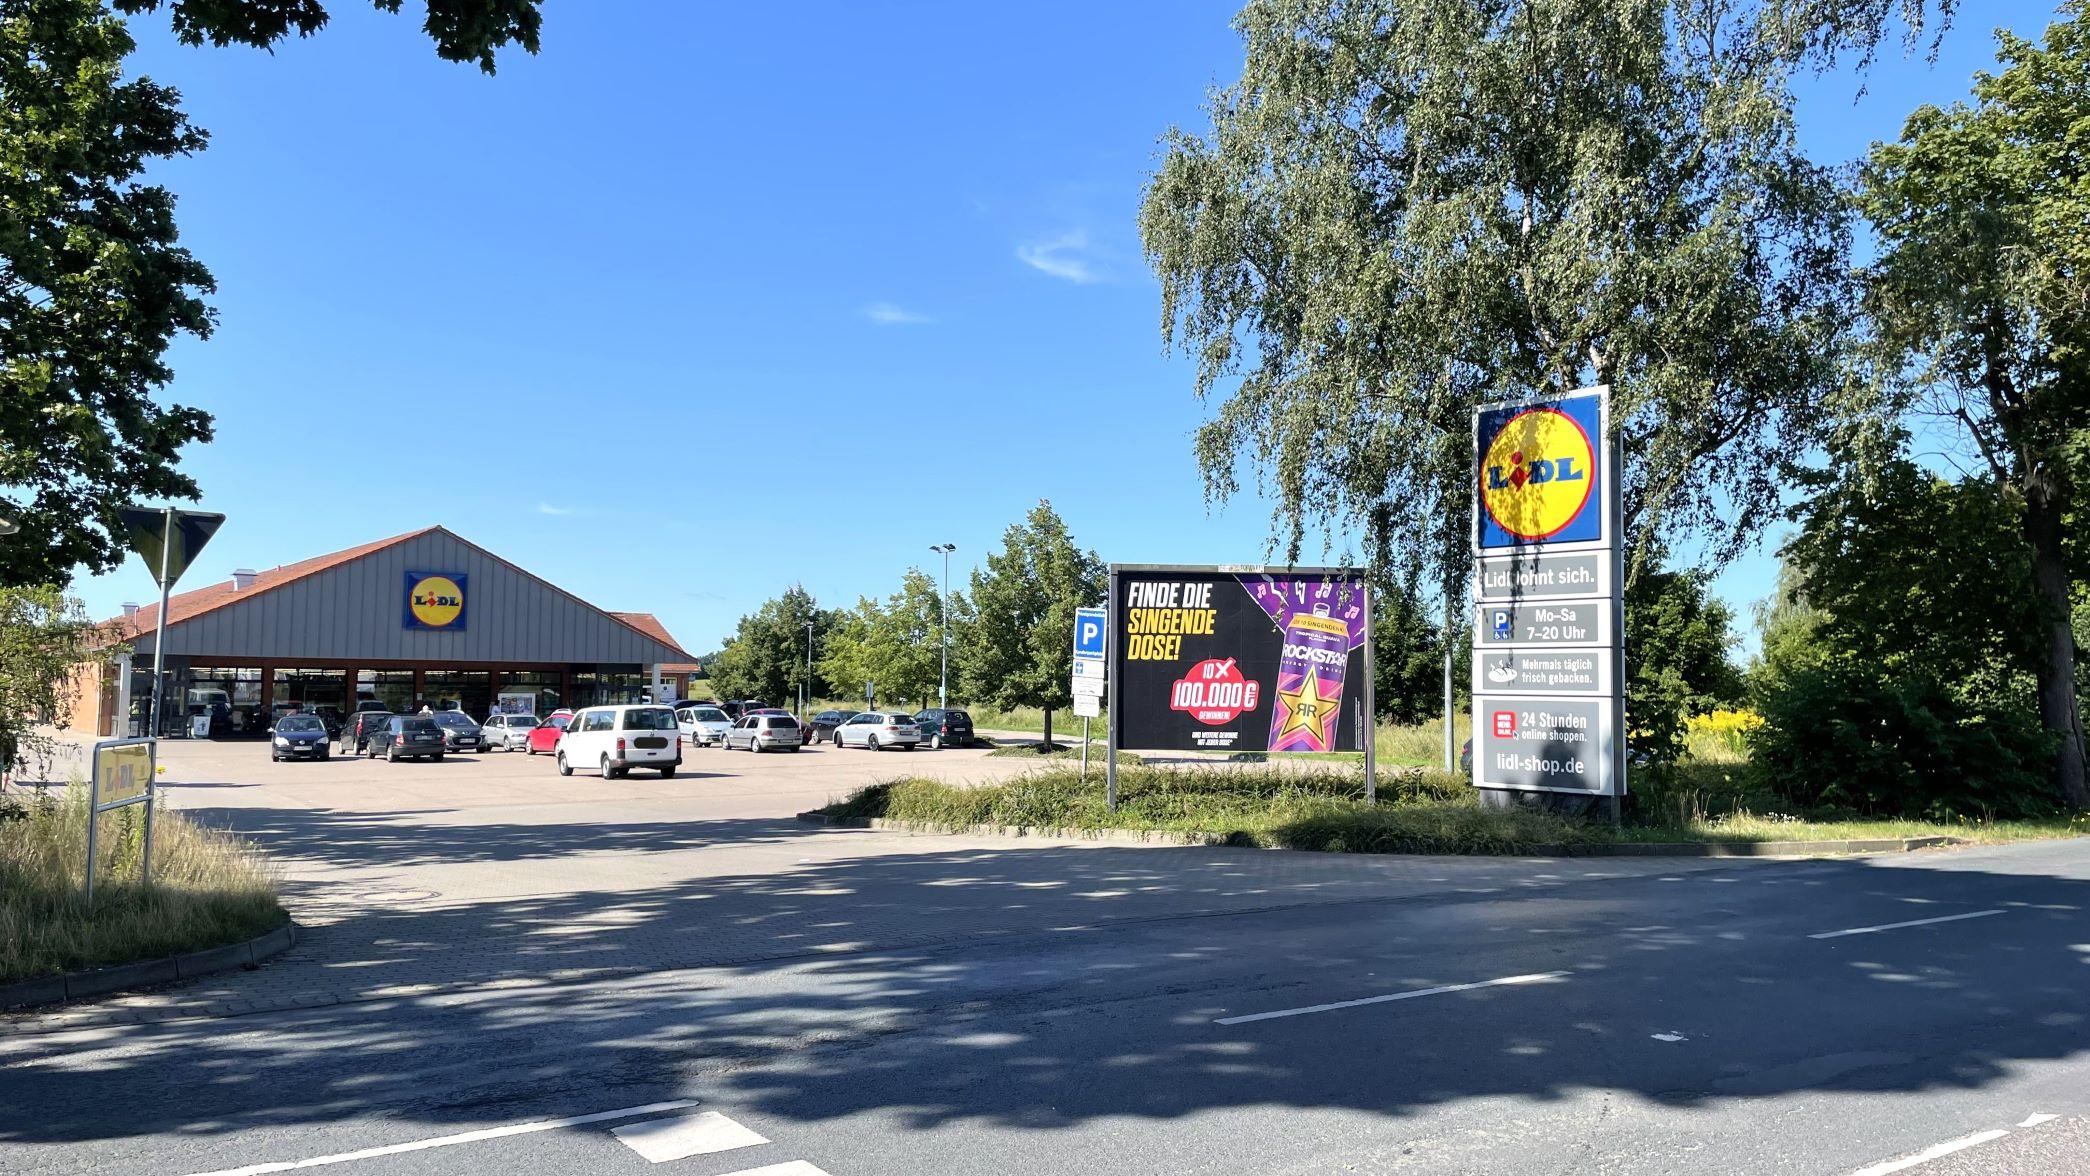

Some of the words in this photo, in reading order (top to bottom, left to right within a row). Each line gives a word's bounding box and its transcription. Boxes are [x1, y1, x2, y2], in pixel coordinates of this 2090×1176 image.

[1485, 570, 1511, 588] Lidl
[1516, 568, 1554, 586] lohnt
[1558, 566, 1595, 584] sich.
[1127, 581, 1180, 608] FINDE
[1182, 582, 1213, 608] DIE
[1127, 608, 1217, 635] SINGENDE
[1562, 625, 1586, 640] Uhr
[1082, 622, 1098, 645] P
[1127, 634, 1182, 660] DOSE!
[1282, 643, 1347, 667] ROCKSTAR
[1522, 658, 1562, 670] Mehrmals
[1563, 658, 1593, 672] täglich
[1522, 672, 1546, 683] frisch
[1548, 671, 1593, 686] gebacken.
[1521, 711, 1536, 727] 24
[1539, 711, 1587, 729] Stunden
[1521, 729, 1547, 740] online
[1549, 729, 1588, 743] shoppen.
[1496, 752, 1585, 776] lidl-shop.de
